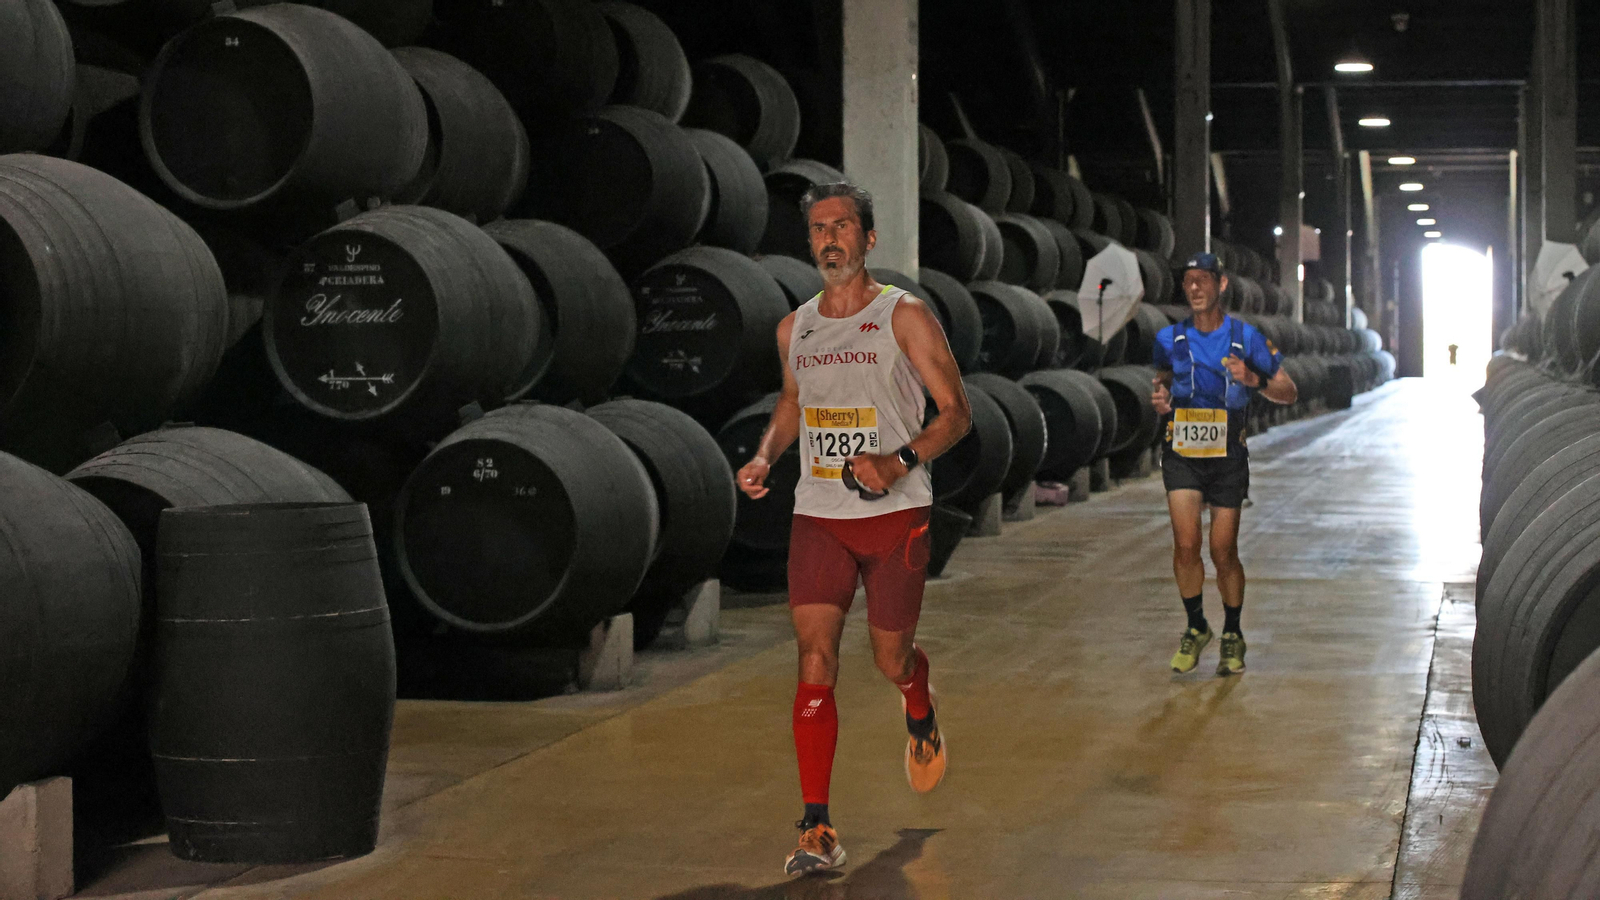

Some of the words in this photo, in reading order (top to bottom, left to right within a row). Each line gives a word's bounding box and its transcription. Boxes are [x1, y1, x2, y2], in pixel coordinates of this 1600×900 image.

[795, 351, 878, 371] FUNDADOR
[819, 409, 855, 425] Sherry
[1182, 425, 1219, 442] 1320
[816, 432, 866, 458] 1282
